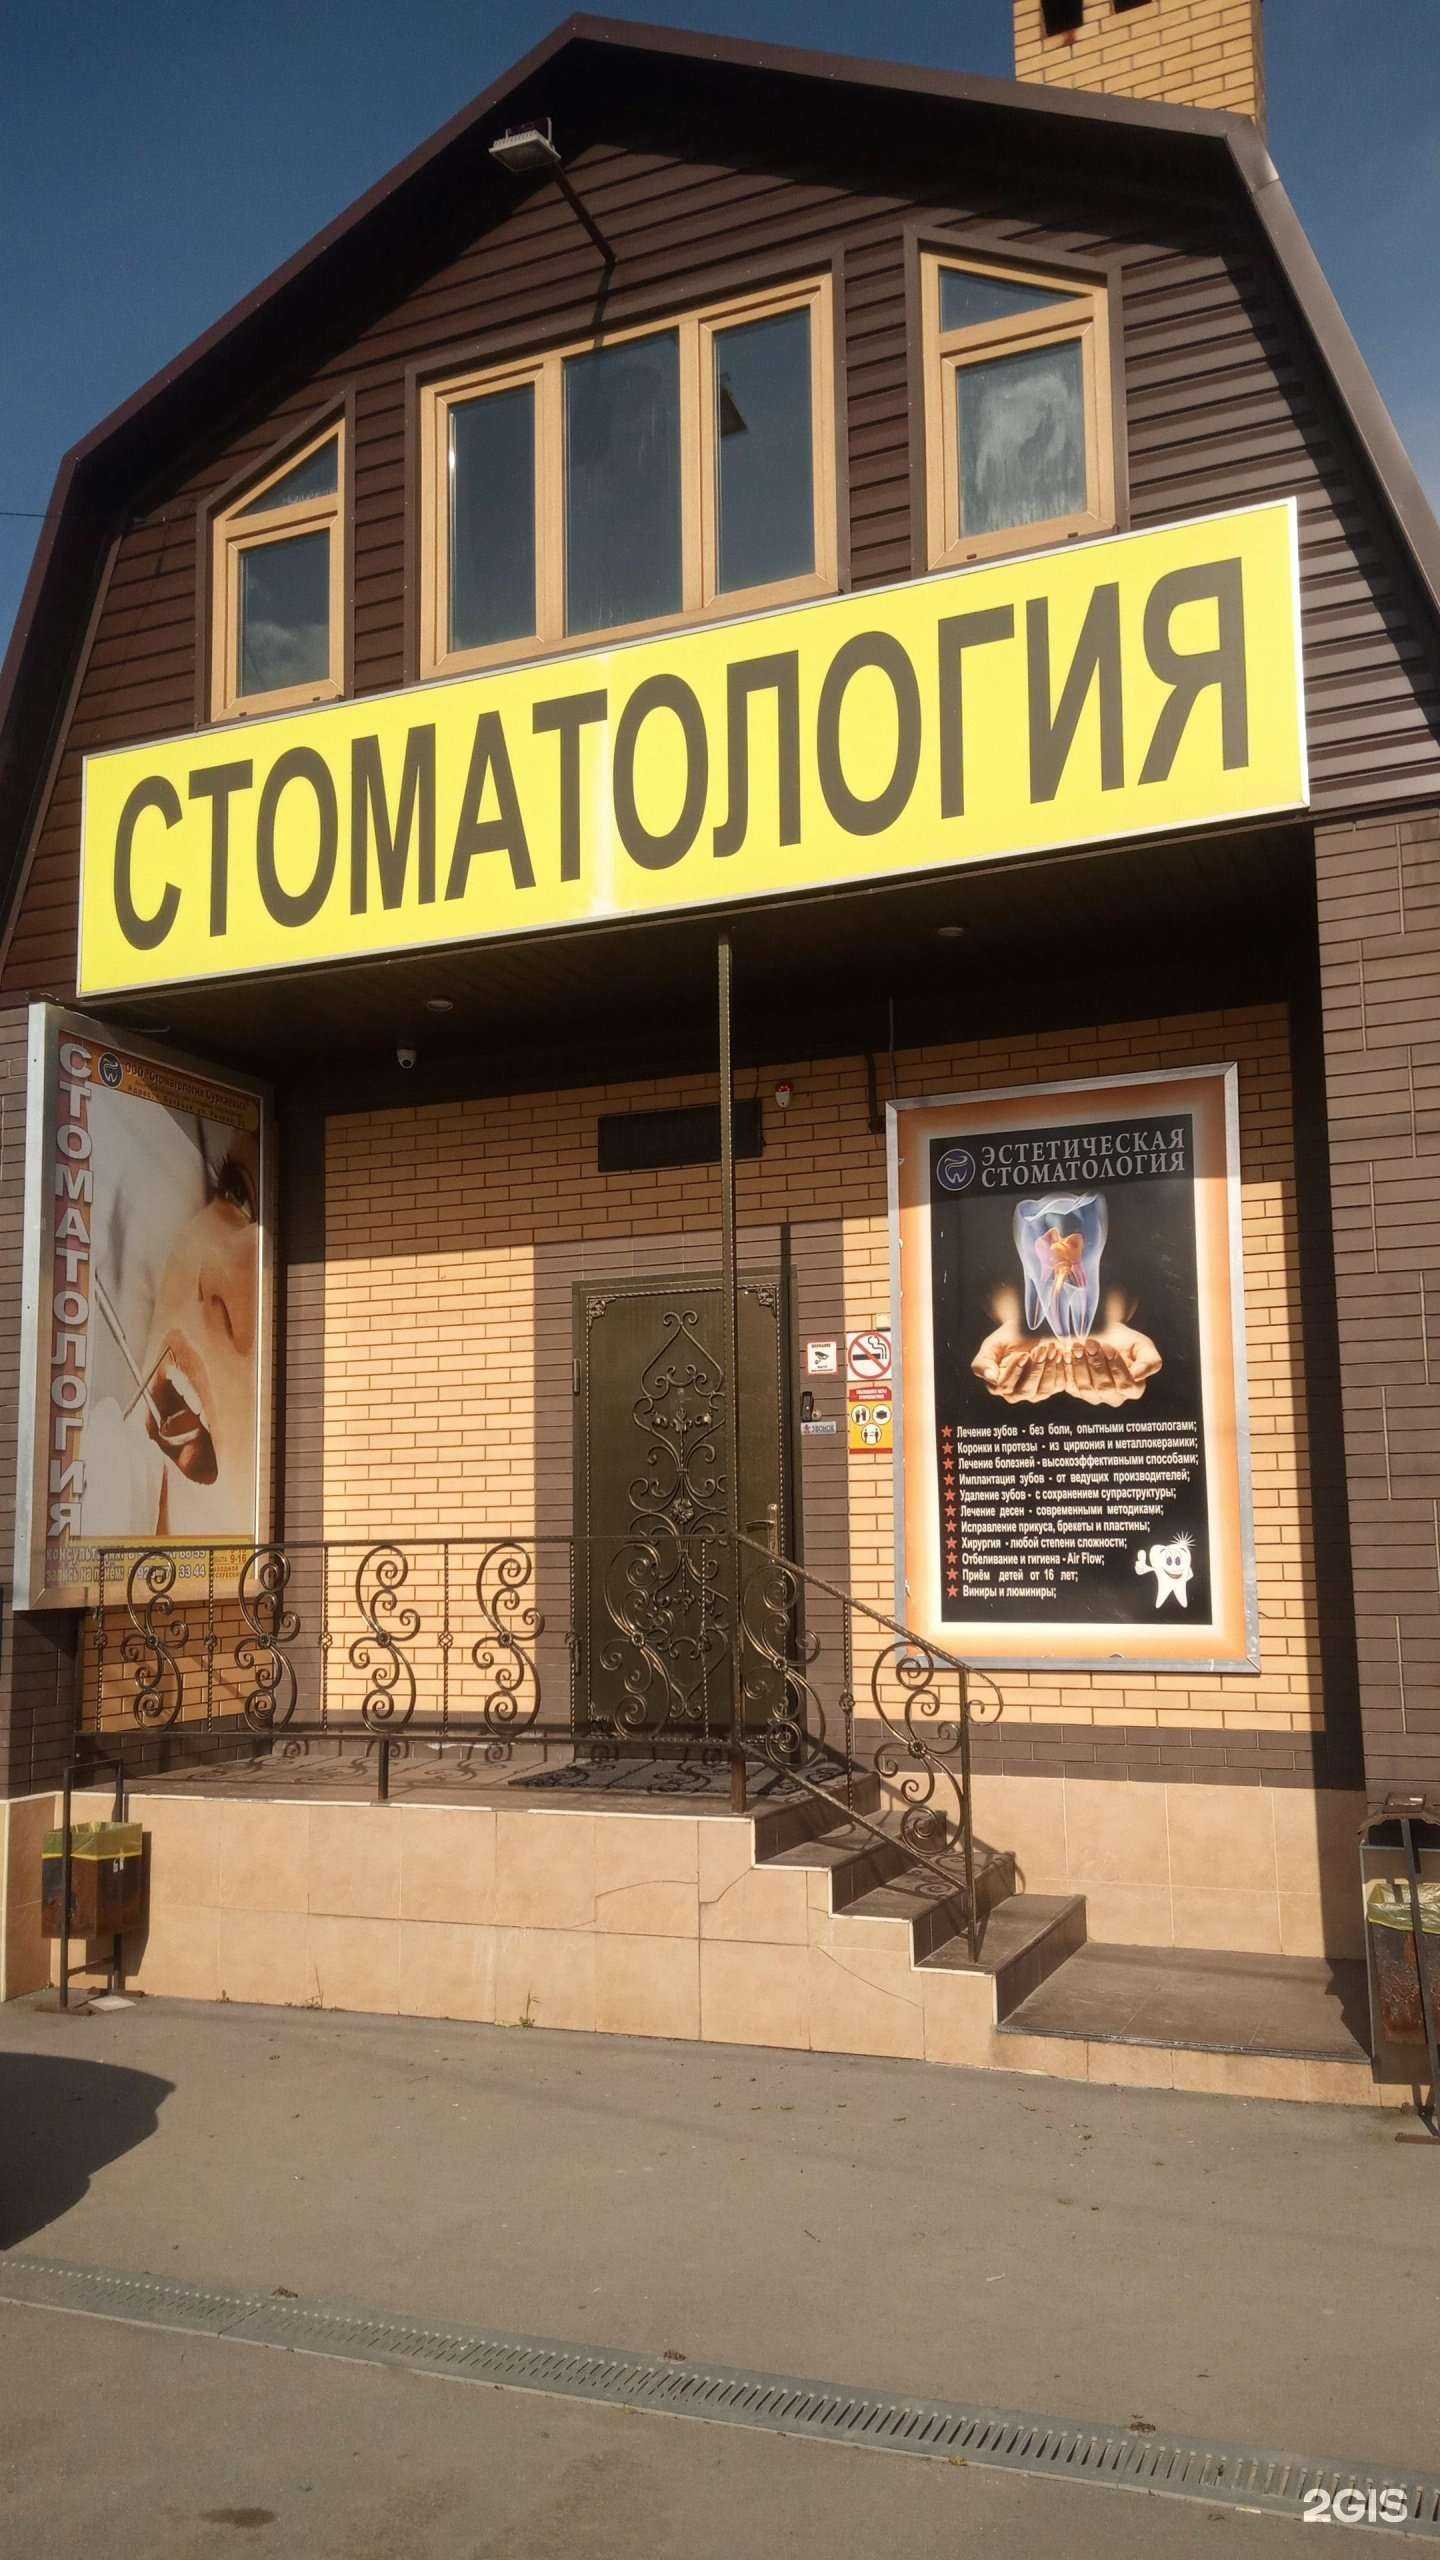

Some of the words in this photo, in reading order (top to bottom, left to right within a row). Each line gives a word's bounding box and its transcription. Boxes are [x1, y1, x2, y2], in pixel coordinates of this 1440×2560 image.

[112, 557, 1249, 951] СТОМАТОЛОГИЯ
[981, 1128, 1185, 1166] ЭСТЕТИЧЕСКАЯ
[981, 1151, 1185, 1188] СТОМАТОЛОГИЯ
[48, 1043, 94, 1537] СТОМАТОЛОГИЯ
[957, 1426, 991, 1438] Лечение
[993, 1425, 1018, 1439] зубов
[1029, 1424, 1044, 1436] без
[1048, 1423, 1072, 1436] боли,
[1076, 1424, 1124, 1434] опытными
[1126, 1421, 1197, 1432] стоматологами;
[957, 1442, 992, 1456] Коронки
[994, 1444, 1000, 1452] и
[1002, 1443, 1038, 1455] протезы
[1049, 1442, 1060, 1450] из
[1064, 1440, 1106, 1453] циркония
[1108, 1440, 1113, 1449] и
[1115, 1437, 1198, 1450] металлокерамики;
[959, 1458, 993, 1469] Лечение
[996, 1456, 1035, 1469] болезней
[1042, 1454, 1144, 1469] высокоэффективными
[1146, 1452, 1199, 1465] способами;
[959, 1474, 1016, 1485] Имплантация
[1020, 1472, 1044, 1487] зубов
[1056, 1474, 1066, 1482] от
[1070, 1473, 1109, 1485] ведущих
[1114, 1468, 1190, 1484] производителей;
[960, 1489, 999, 1502] Удаление
[1001, 1488, 1026, 1503] зубов
[1035, 1490, 1040, 1498] с
[1042, 1489, 1100, 1502] сохранением
[961, 1505, 995, 1517] Лечение
[1000, 1506, 1024, 1518] десен
[1036, 1505, 1102, 1518] современными
[1107, 1504, 1164, 1516] методиками;
[961, 1521, 1016, 1534] Исправление
[1018, 1522, 1056, 1534] прикуса,
[1057, 1520, 1094, 1534] брекеты
[1096, 1522, 1101, 1531] и
[1104, 1521, 1150, 1532] пластины;
[961, 1537, 1000, 1551] Хирургия
[1010, 1536, 1038, 1548] любой
[1041, 1539, 1075, 1549] степени
[1077, 1538, 1127, 1549] сложности;
[962, 1553, 1018, 1565] Отбеливание
[1020, 1556, 1026, 1564] и
[1028, 1555, 1060, 1565] гигиена
[1067, 1552, 1080, 1564] Air
[1082, 1552, 1104, 1566] Flow;
[179, 1565, 191, 1578] 33
[193, 1564, 205, 1577] 44
[962, 1569, 990, 1582] Приём
[999, 1569, 1024, 1582] детей
[1030, 1571, 1040, 1580] от
[1044, 1569, 1054, 1580] 16
[1061, 1570, 1078, 1582] лет;
[963, 1585, 997, 1599] Виниры
[999, 1588, 1005, 1596] и
[1006, 1587, 1056, 1599] люминиры;
